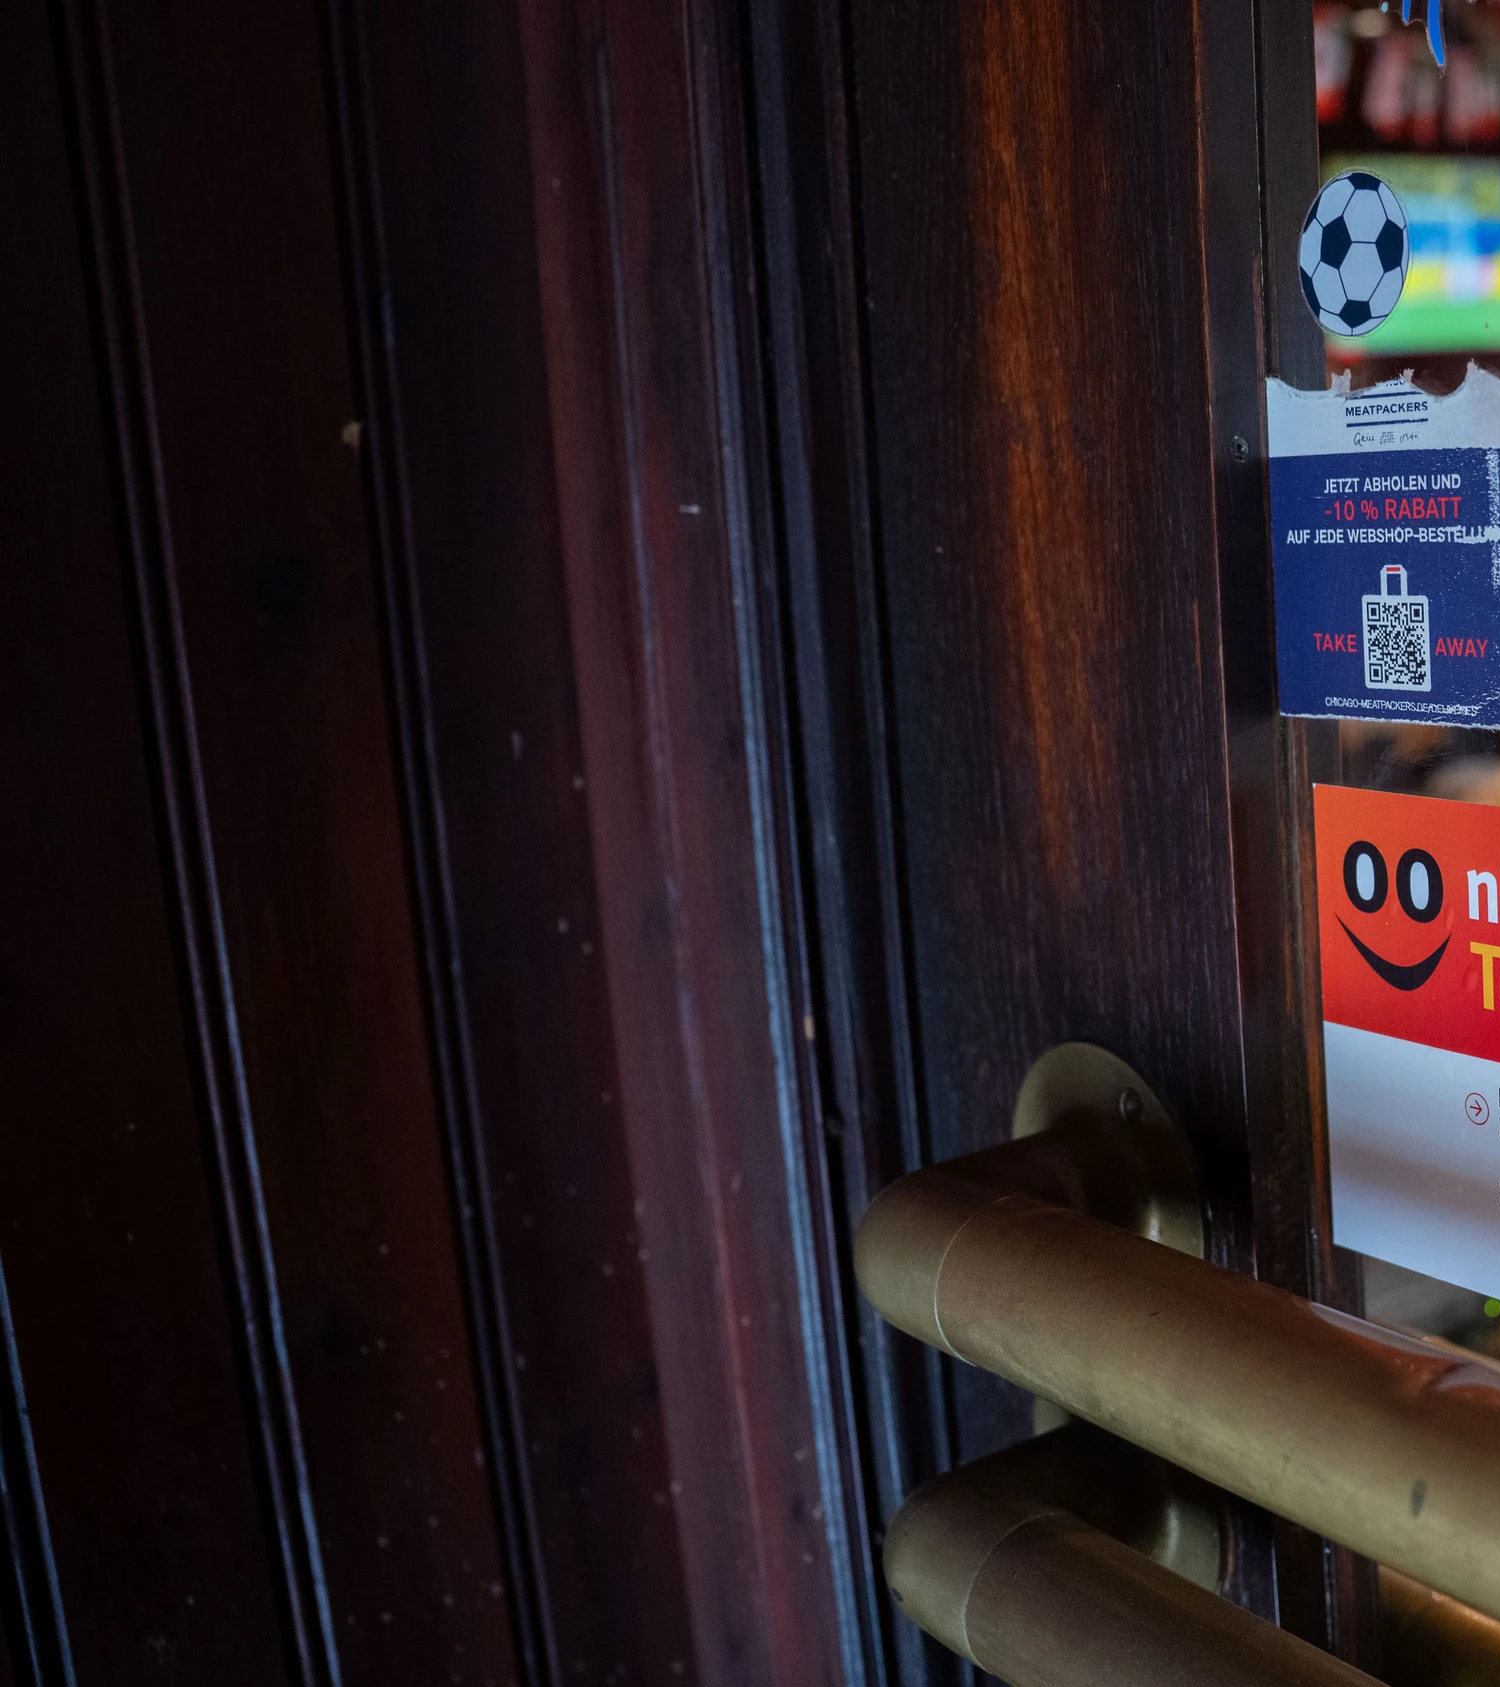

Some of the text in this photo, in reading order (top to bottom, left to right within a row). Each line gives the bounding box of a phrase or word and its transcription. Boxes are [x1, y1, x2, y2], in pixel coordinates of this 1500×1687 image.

[1345, 401, 1428, 417] MEATPACKERS
[1324, 473, 1461, 494] JETZT ABHOLEN UND
[1325, 496, 1462, 521] -10 % RABATT
[1286, 529, 1310, 544] AUF
[1314, 529, 1344, 544] JEDE
[1314, 633, 1488, 658] TAKE AWAY
